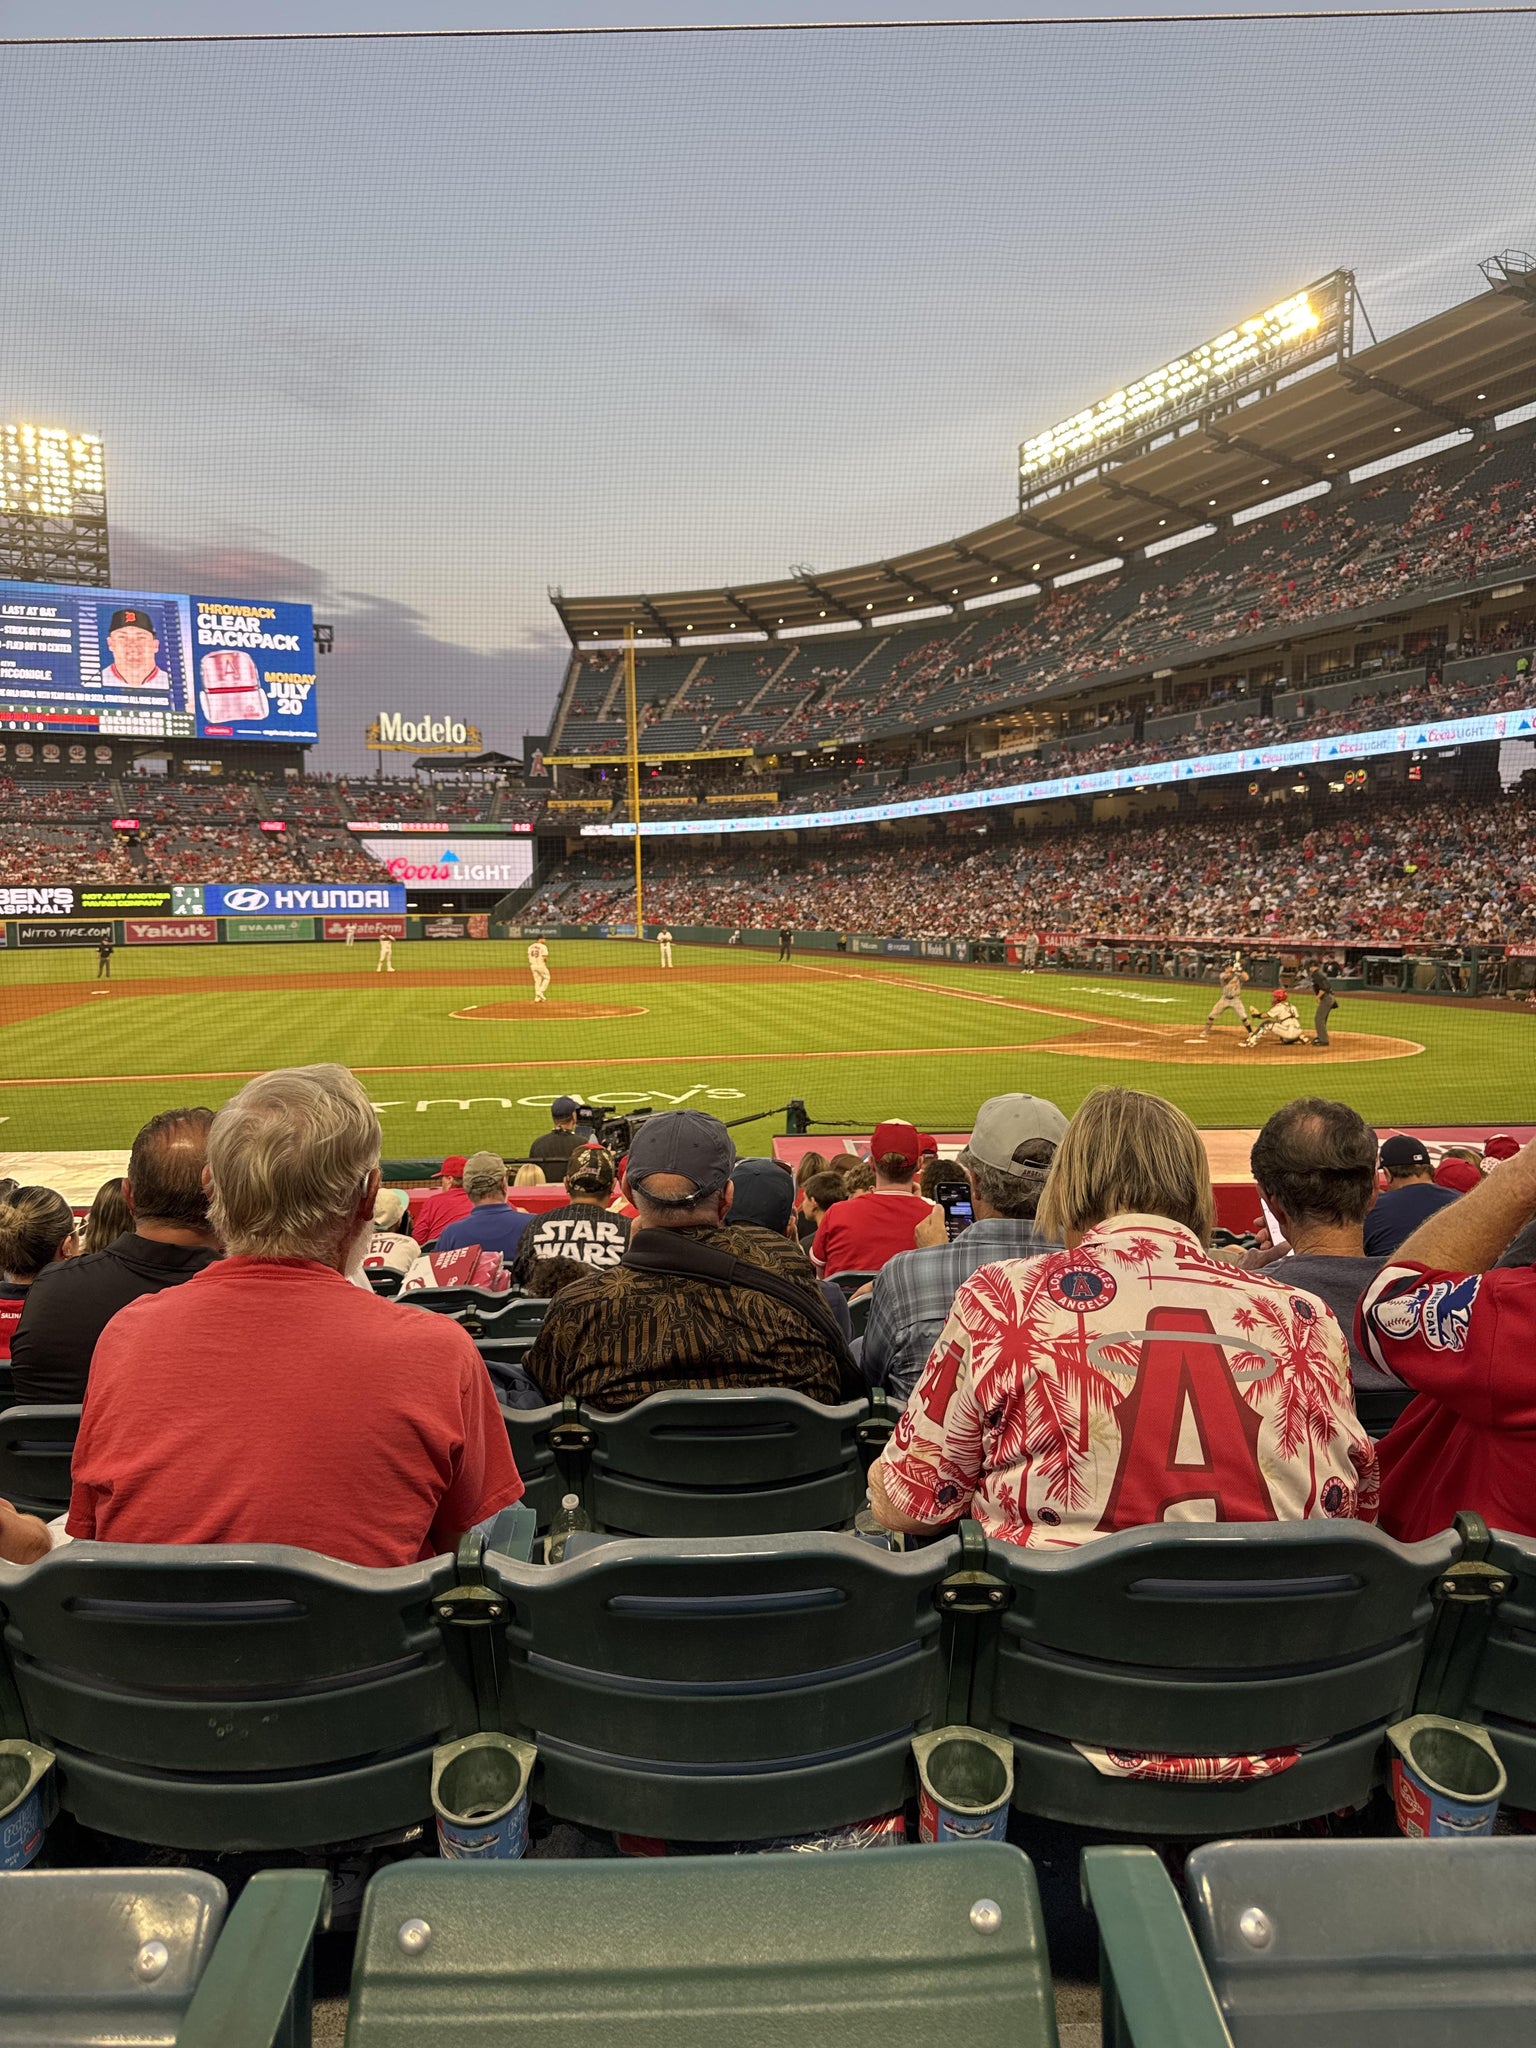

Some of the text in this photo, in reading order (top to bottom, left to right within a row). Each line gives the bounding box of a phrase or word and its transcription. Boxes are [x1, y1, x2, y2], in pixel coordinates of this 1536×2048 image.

[2, 605, 57, 617] LAST AT BAT
[197, 603, 276, 619] THROWBACK
[197, 613, 261, 633] CLEAR
[198, 629, 300, 651] BACKPACK
[264, 671, 317, 685] MONDAY
[267, 682, 311, 700] JULY
[277, 699, 303, 715] 20
[380, 712, 467, 743] Modelo
[1457, 726, 1484, 739] LIGHT
[386, 857, 512, 881] Coors LIGHT
[0, 887, 74, 905] BEN'S
[126, 892, 171, 900] ANOTHER
[275, 890, 390, 909] HYUNDAI
[131, 924, 211, 938] Yakult
[533, 1220, 625, 1244] STAR
[370, 1240, 395, 1253] ETO
[533, 1242, 625, 1266] WARS
[1050, 1266, 1114, 1291] LOS ANGELES
[1058, 1294, 1109, 1310] ANGELS
[1426, 1287, 1445, 1337] AMERICAN
